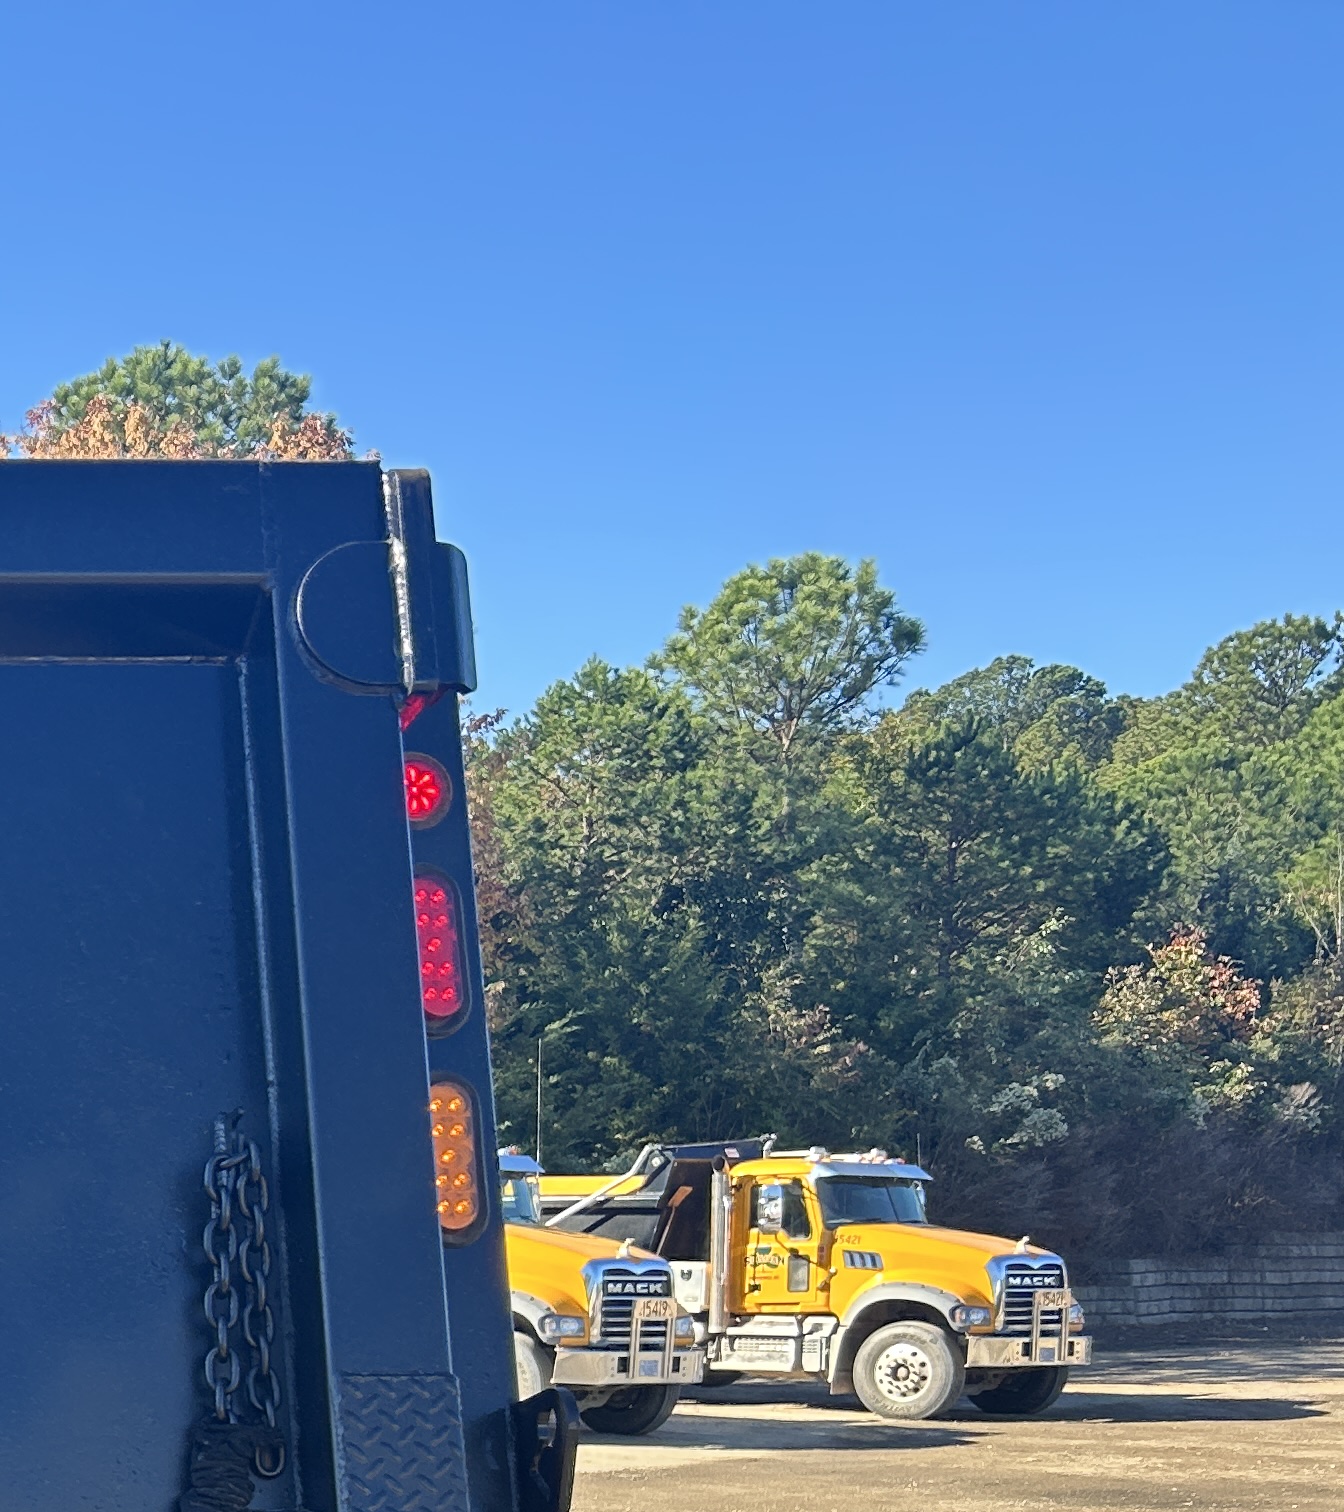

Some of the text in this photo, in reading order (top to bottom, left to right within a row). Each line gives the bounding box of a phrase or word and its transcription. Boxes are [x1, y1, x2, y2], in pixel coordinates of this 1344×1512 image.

[1008, 1276, 1056, 1286] MACK
[607, 1282, 663, 1293] MACK
[641, 1300, 668, 1317] 15419
